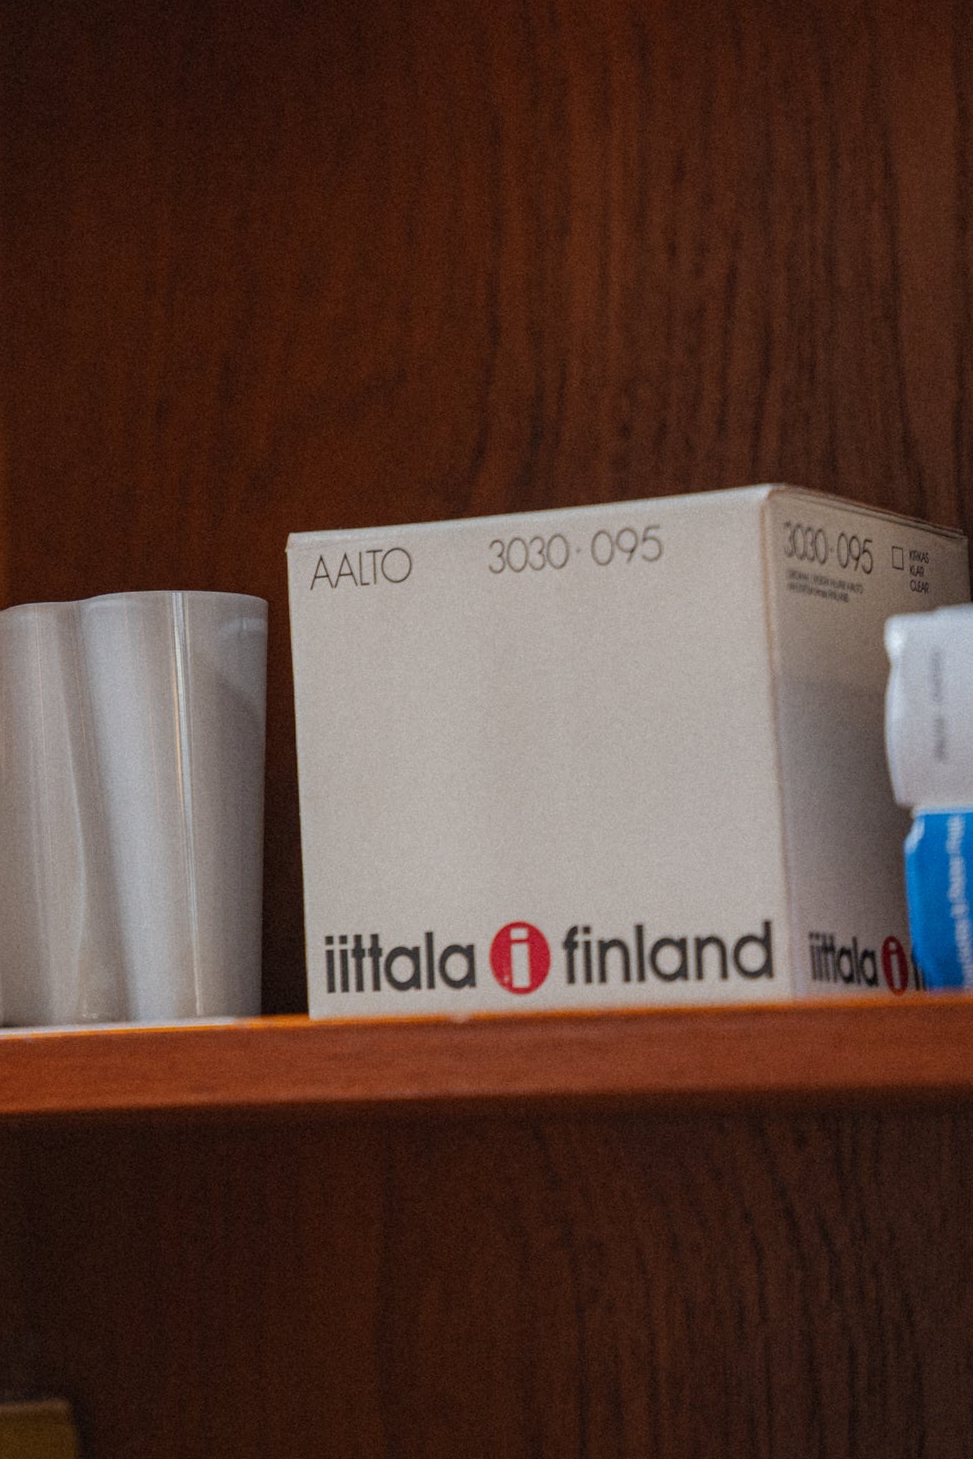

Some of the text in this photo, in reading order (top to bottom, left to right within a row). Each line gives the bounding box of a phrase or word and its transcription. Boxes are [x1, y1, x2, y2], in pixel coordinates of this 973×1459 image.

[309, 546, 413, 590] AALTO
[324, 931, 477, 994] iittala
[562, 919, 776, 985] finland
[808, 931, 880, 988] iittala
